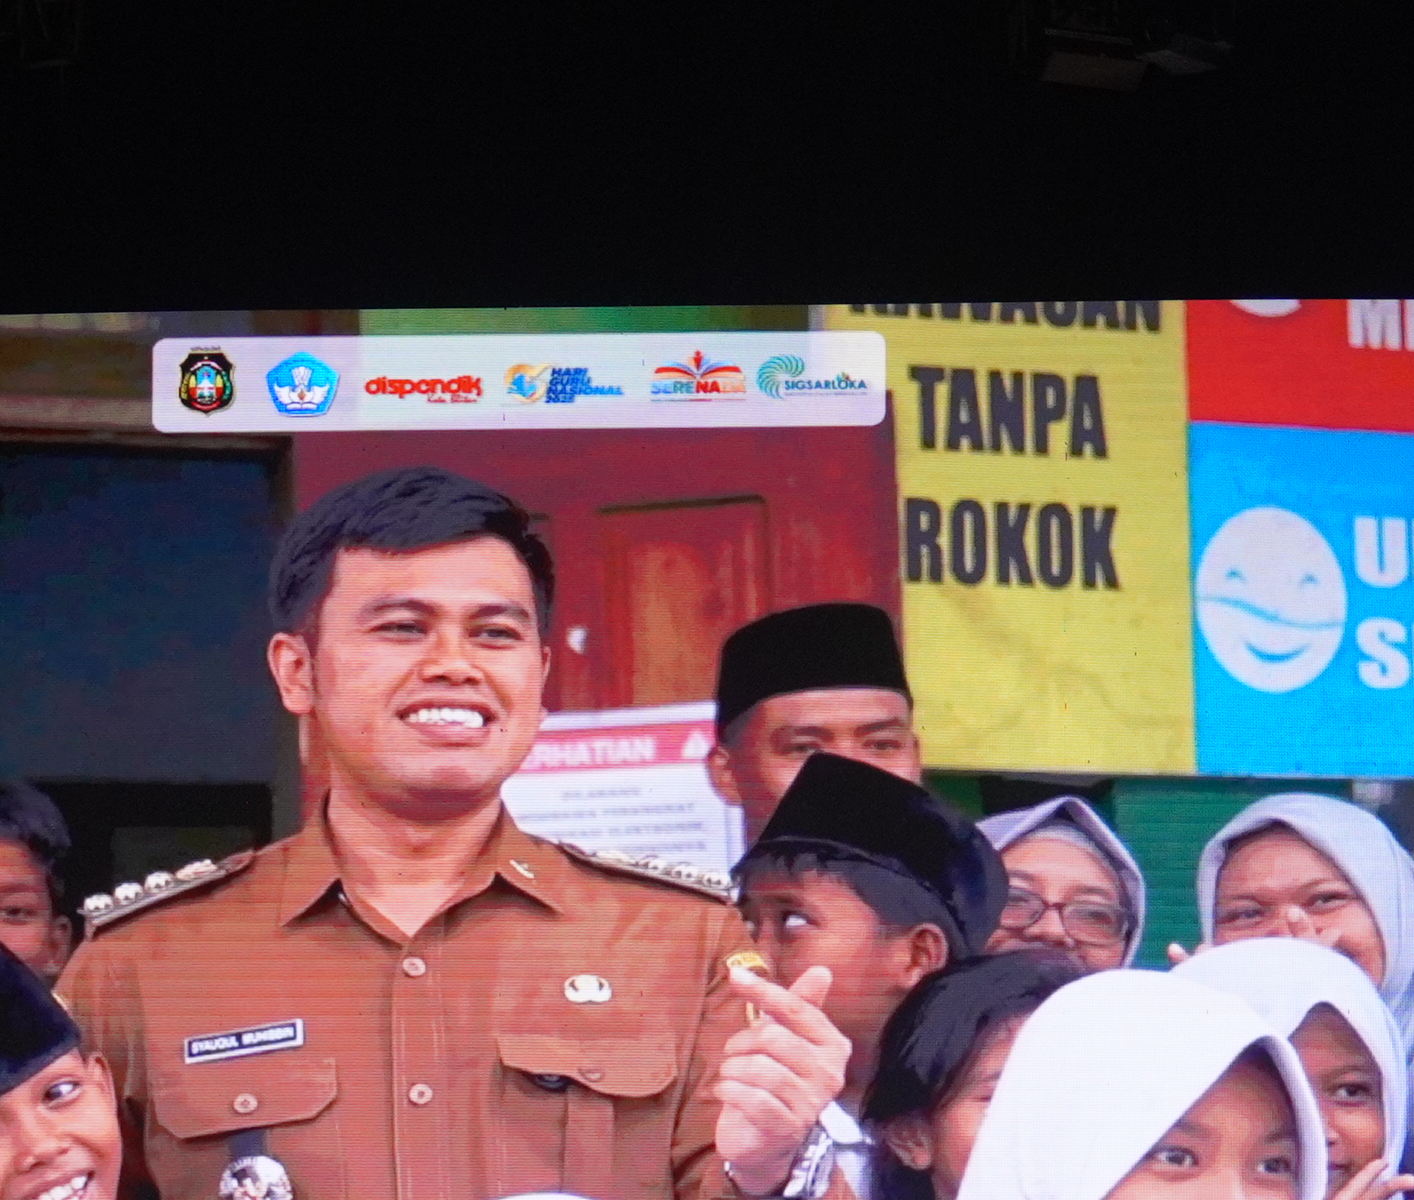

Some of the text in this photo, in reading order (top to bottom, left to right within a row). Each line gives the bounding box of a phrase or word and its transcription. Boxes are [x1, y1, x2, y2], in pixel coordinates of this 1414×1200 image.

[784, 379, 867, 391] SIGSARLOKA
[907, 365, 1108, 458] TANPA
[905, 498, 1120, 589] ROKOK
